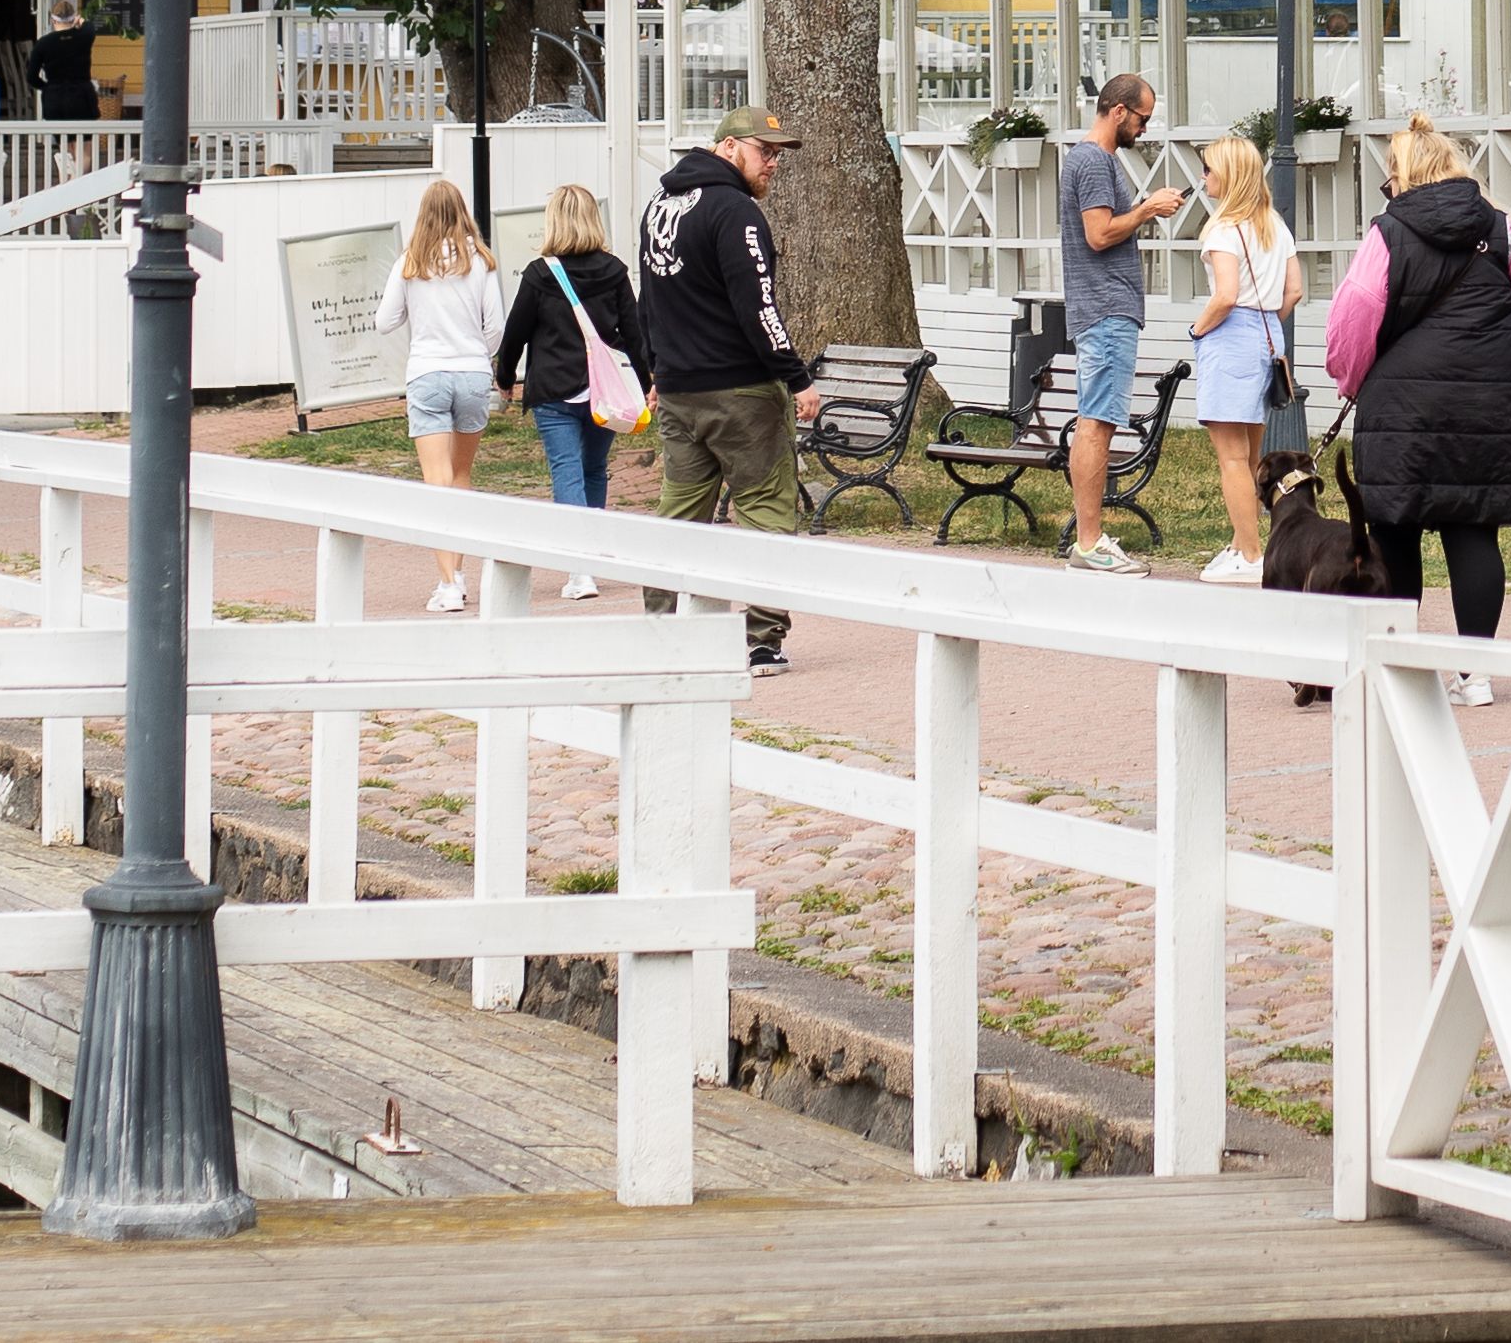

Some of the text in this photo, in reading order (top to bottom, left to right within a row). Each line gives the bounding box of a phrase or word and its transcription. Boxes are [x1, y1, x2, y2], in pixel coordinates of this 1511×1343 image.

[759, 275, 773, 304] TOO
[312, 298, 337, 313] Why
[342, 295, 365, 305] have
[314, 313, 343, 324] when
[763, 305, 791, 350] SHORT
[325, 328, 348, 337] have
